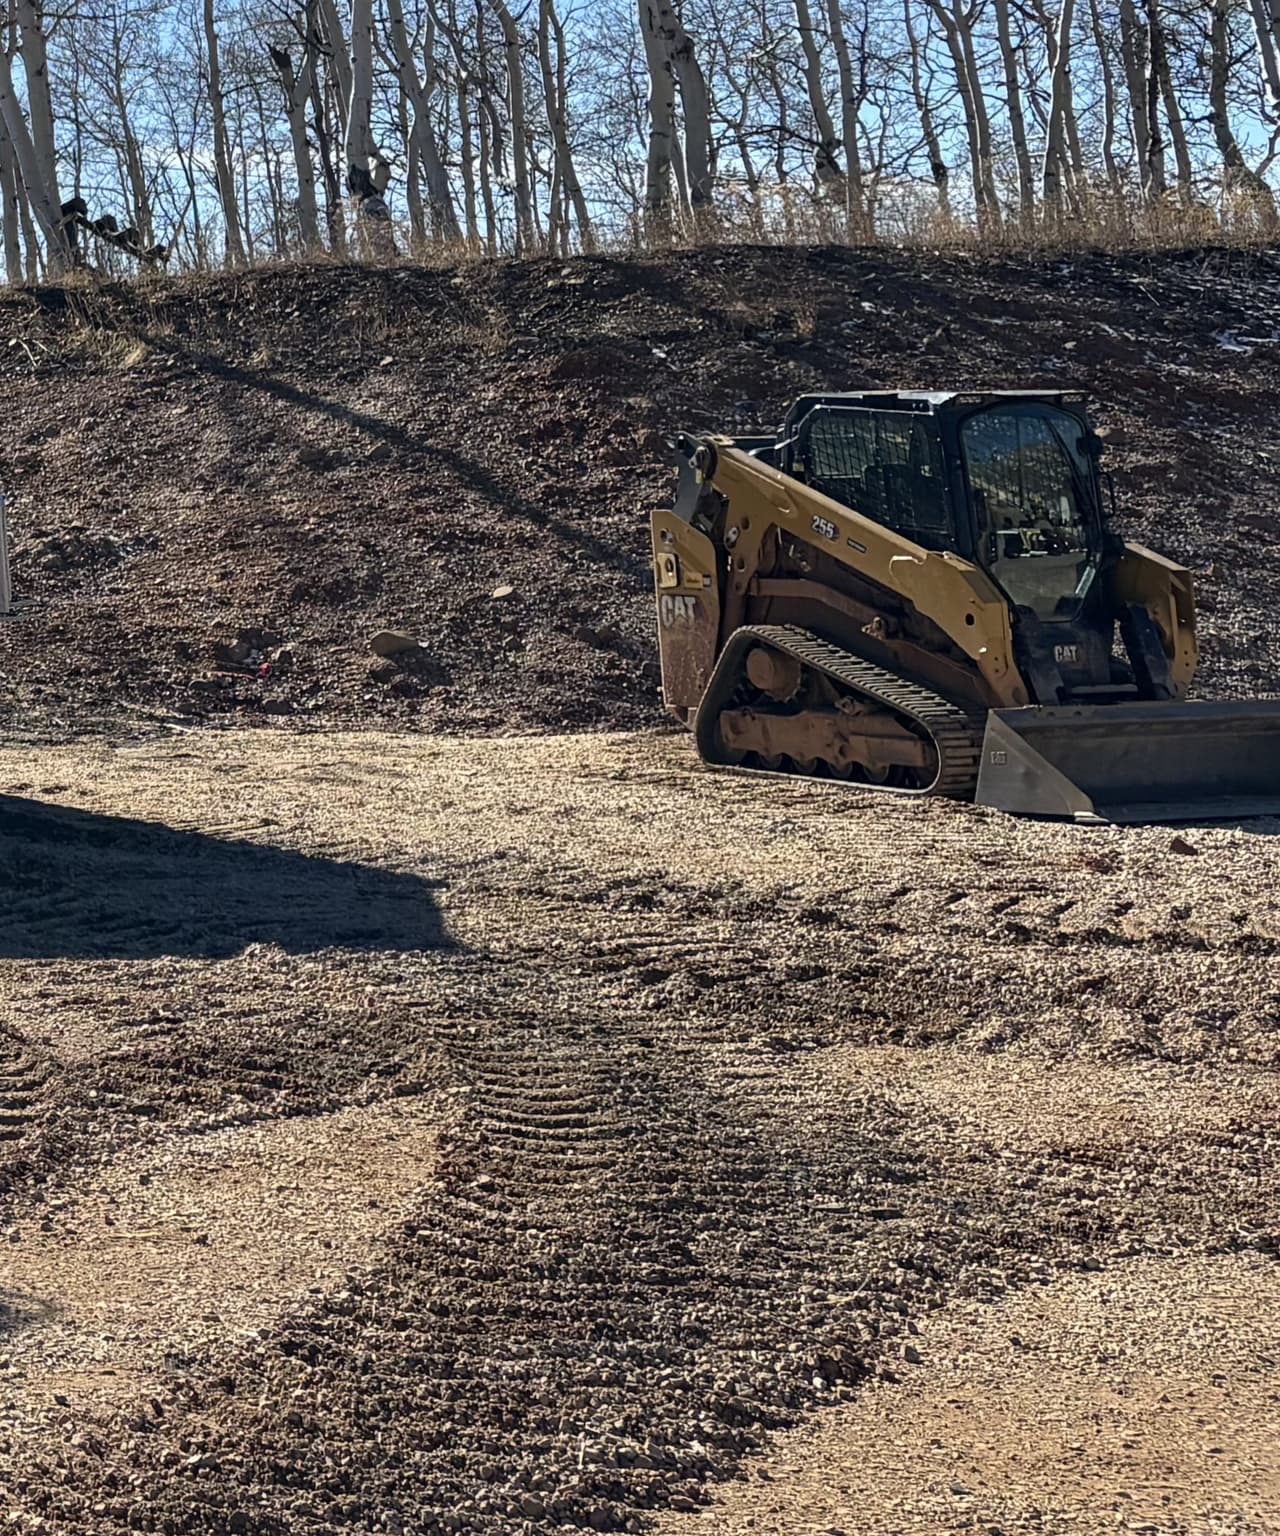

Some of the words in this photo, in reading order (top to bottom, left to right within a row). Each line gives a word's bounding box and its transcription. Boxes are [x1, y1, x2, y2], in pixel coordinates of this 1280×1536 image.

[811, 515, 835, 538] 255
[661, 594, 697, 627] CAT
[1054, 645, 1077, 663] CAT
